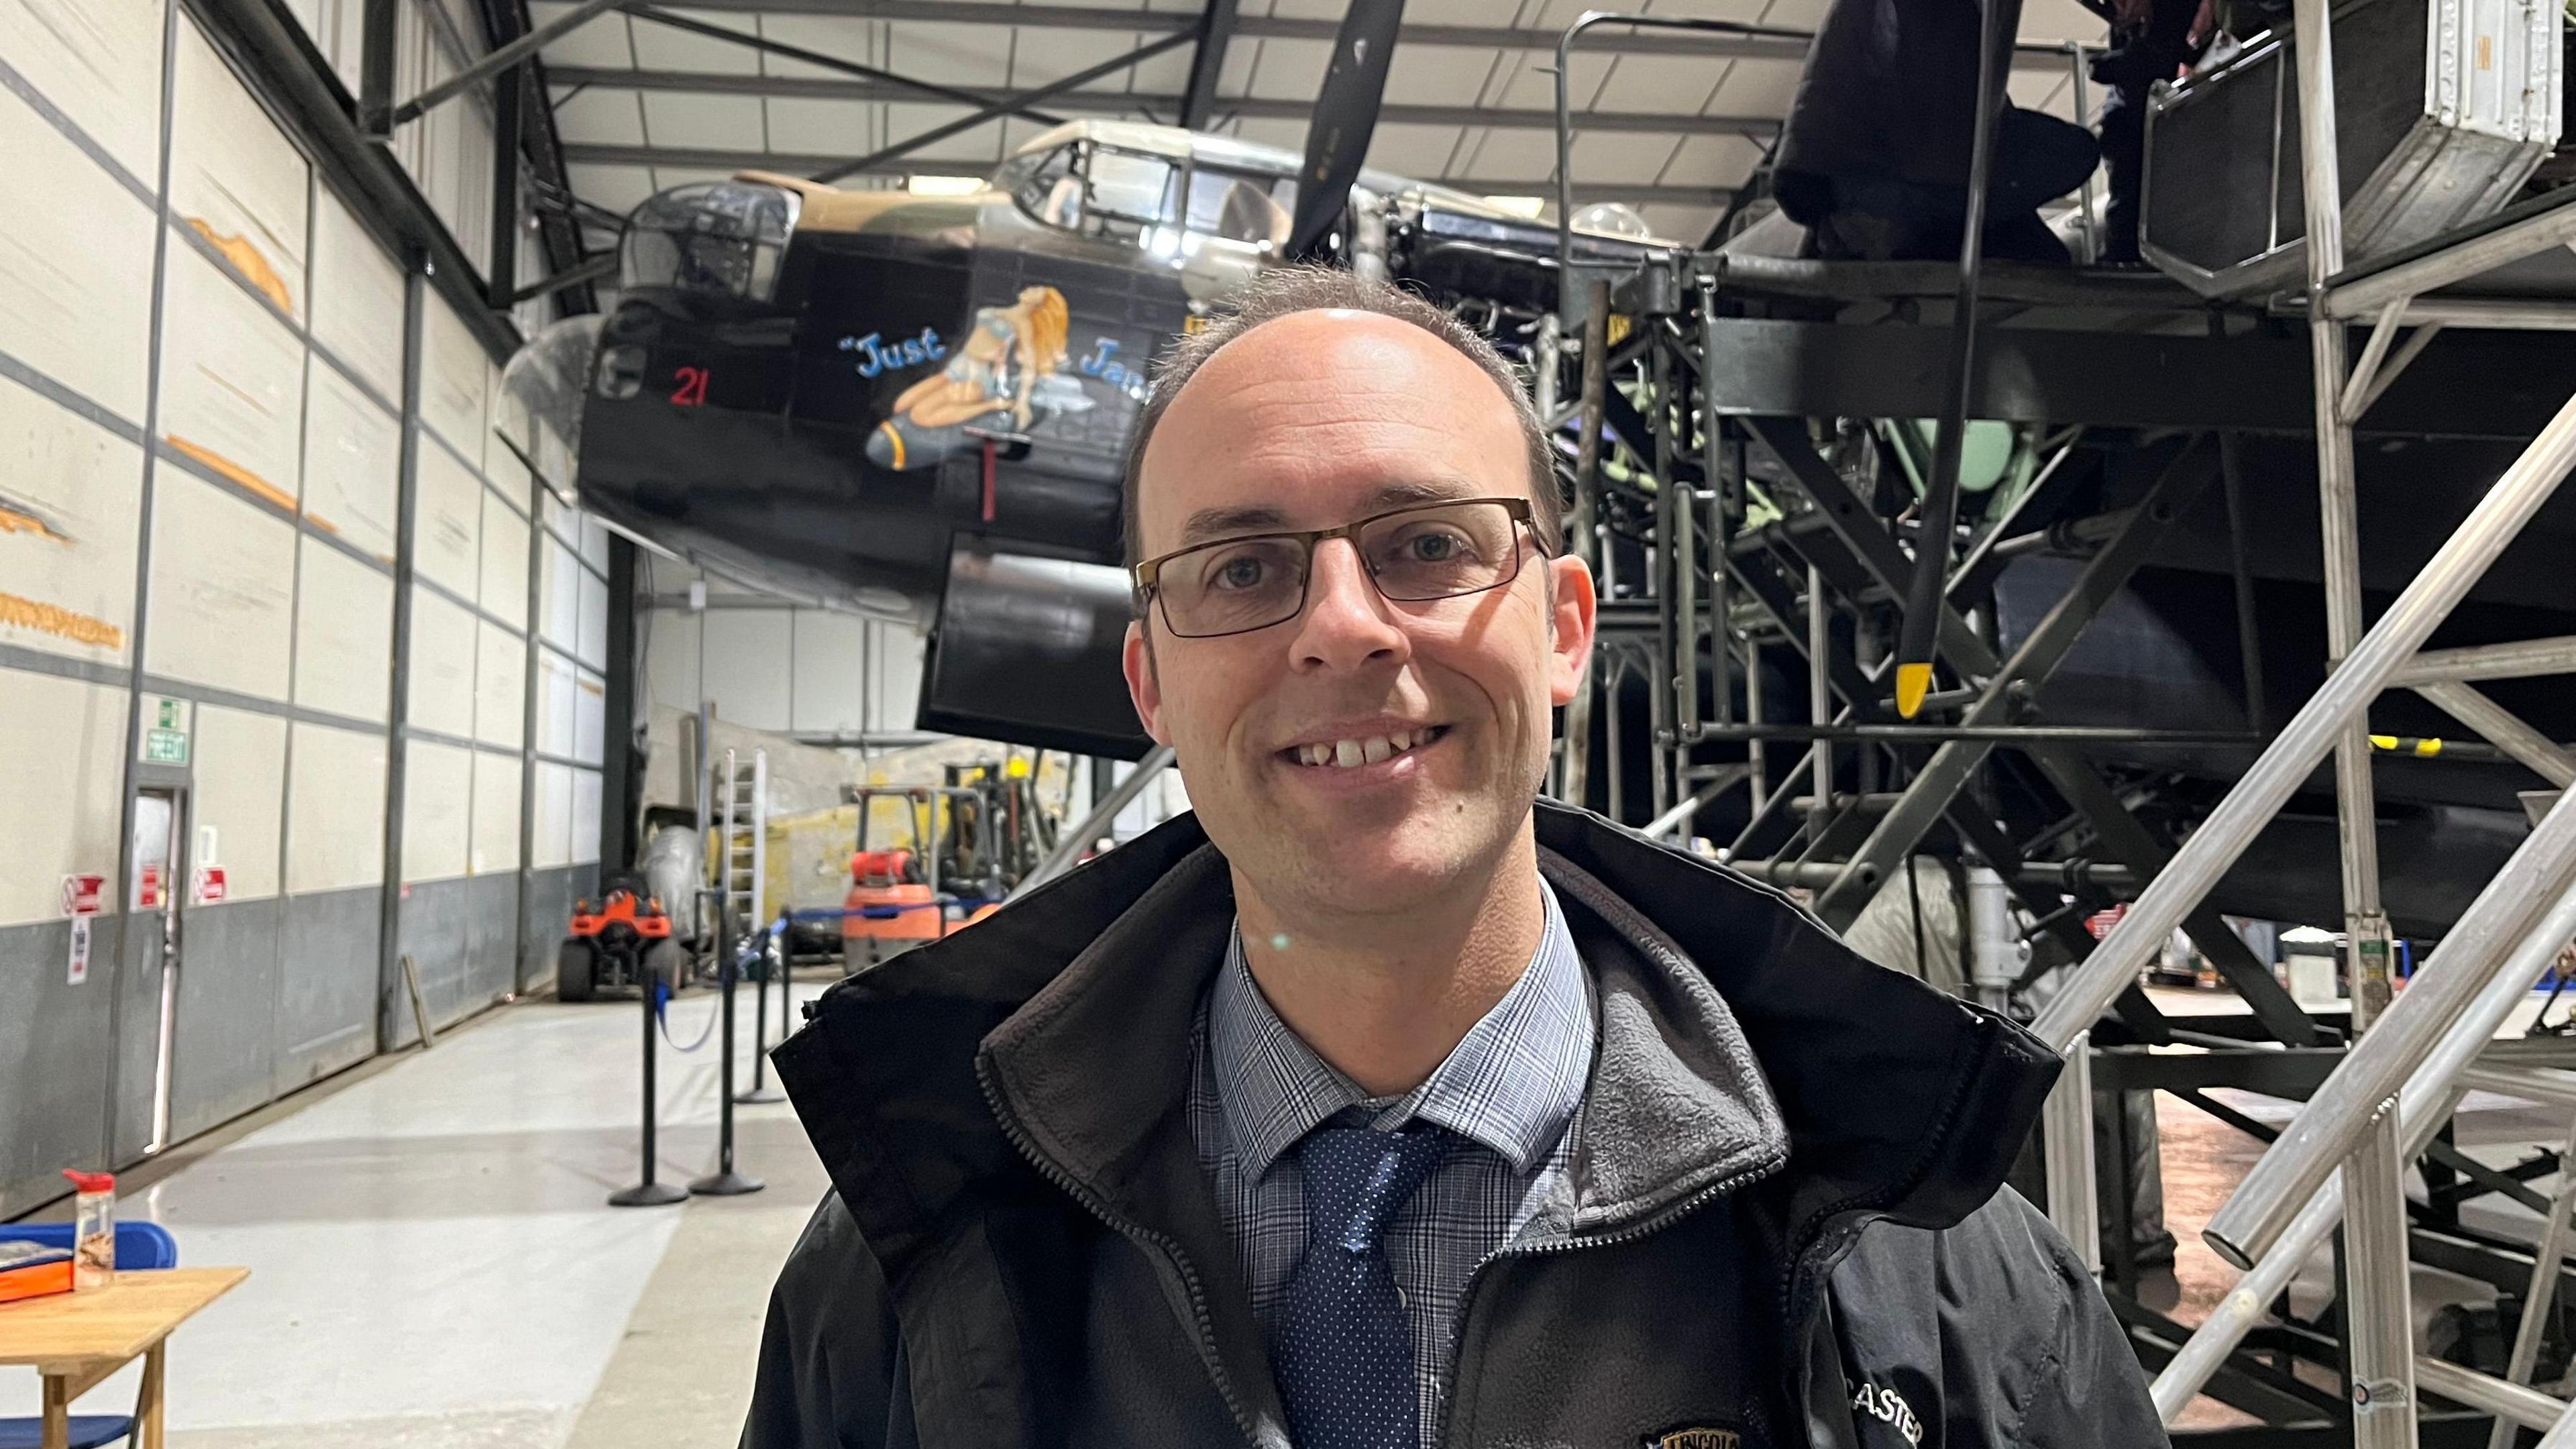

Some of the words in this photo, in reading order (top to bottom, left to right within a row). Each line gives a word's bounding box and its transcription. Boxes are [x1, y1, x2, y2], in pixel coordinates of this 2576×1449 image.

[671, 366, 709, 407] 21
[1079, 337, 1146, 398] Jan
[1847, 1379, 1923, 1449] ASTER
